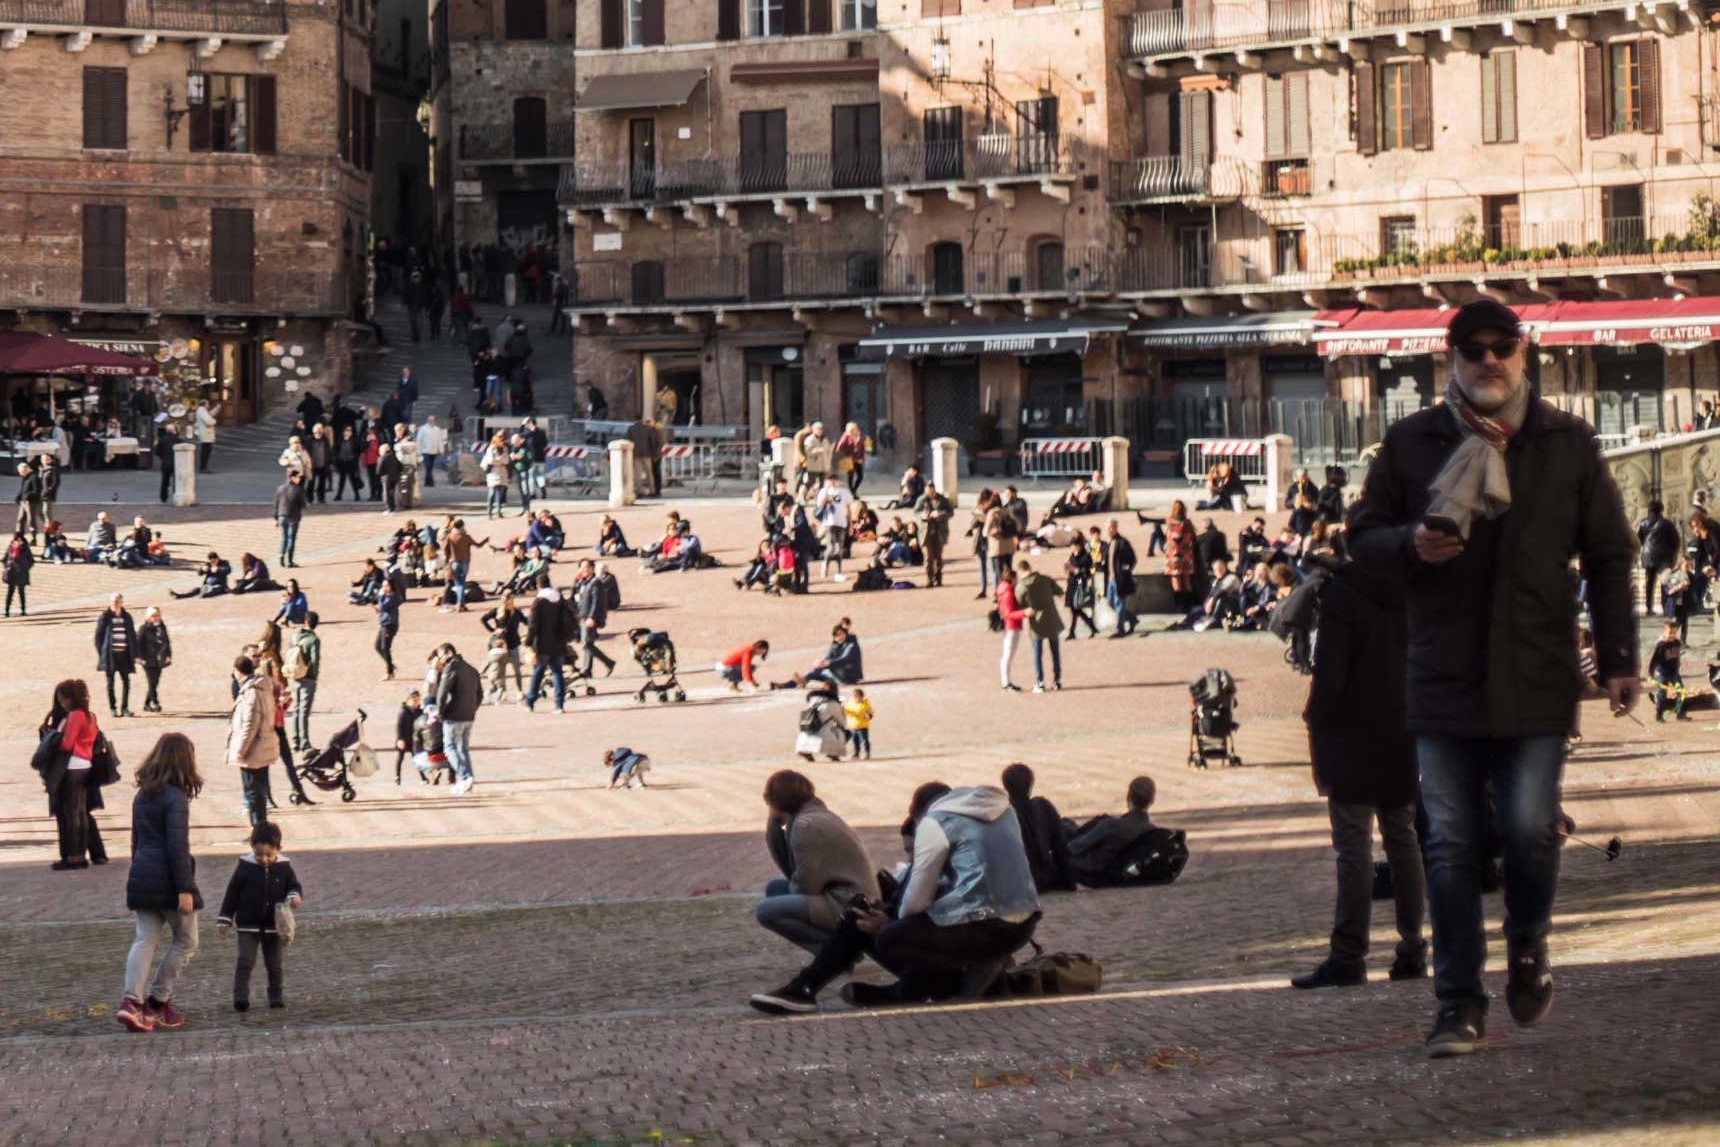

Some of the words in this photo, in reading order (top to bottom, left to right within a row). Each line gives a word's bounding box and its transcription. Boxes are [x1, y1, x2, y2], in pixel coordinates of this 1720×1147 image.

[1594, 328, 1616, 342] BAR
[1650, 325, 1712, 341] GELATERIA
[112, 343, 145, 353] SIENA
